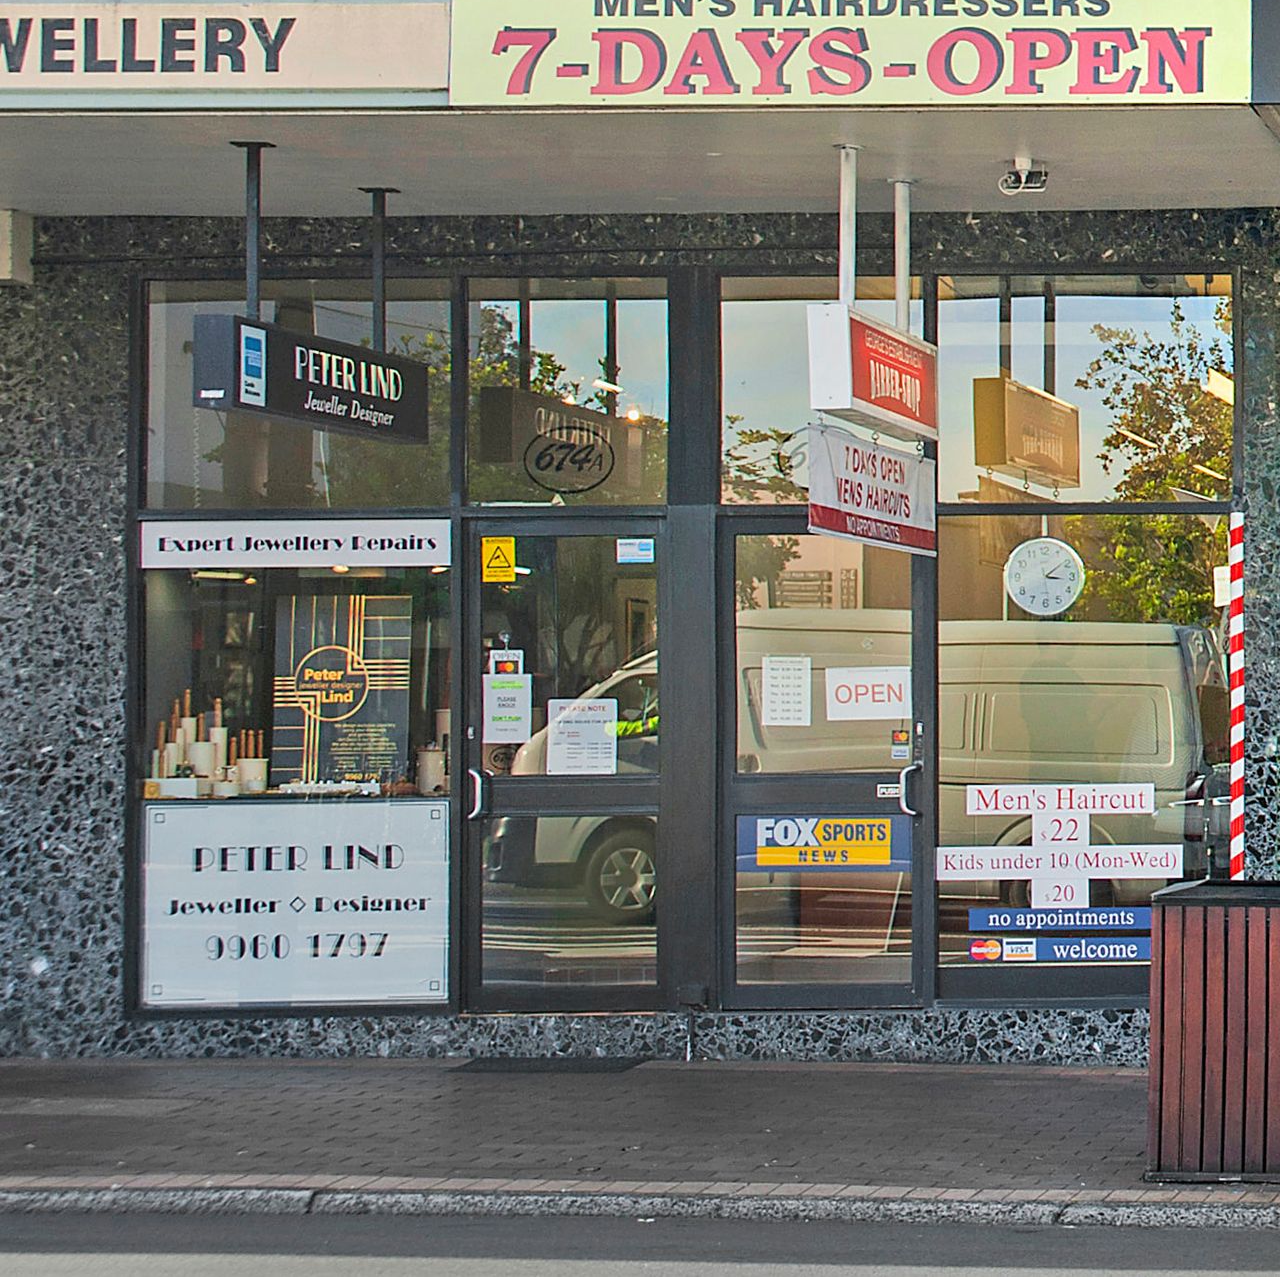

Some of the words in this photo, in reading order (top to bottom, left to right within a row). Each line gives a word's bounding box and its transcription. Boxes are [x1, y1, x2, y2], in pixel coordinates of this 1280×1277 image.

[295, 346, 356, 393] PETER
[360, 361, 403, 402] LIND
[869, 359, 920, 417] BARBER-SHOP
[304, 390, 348, 417] Jeweller
[350, 400, 394, 426] Designer
[535, 443, 603, 472] 674A
[845, 445, 850, 470] 7
[852, 448, 877, 479] DAYS
[880, 455, 905, 485] OPEN
[866, 483, 911, 519] HAIRCUTS
[857, 518, 899, 542] APPOINTMENTS
[157, 536, 235, 552] Expert
[240, 536, 345, 551] Jewellery
[351, 534, 437, 550] Repairs
[303, 668, 344, 681] Peter
[322, 690, 353, 703] Lind
[835, 683, 903, 703] OPEN
[975, 789, 1046, 811] Men's
[1056, 788, 1146, 810] Haircut
[757, 818, 821, 846] FOX
[822, 824, 887, 841] SPORTS
[1041, 819, 1079, 841] $22
[193, 845, 308, 872] PETER
[323, 844, 404, 870] LIND
[799, 850, 848, 862] NEWS
[943, 854, 984, 870] Kids
[990, 853, 1043, 869] under
[1050, 853, 1069, 868] 10
[1075, 852, 1177, 871] (Mon-Wed)
[1045, 885, 1075, 902] $20
[163, 898, 281, 915] Jeweller
[314, 896, 431, 912] Designer
[988, 913, 1011, 926] no
[1016, 909, 1134, 929] appointments
[205, 934, 290, 960] 9960
[306, 932, 389, 958] 1797
[1053, 939, 1138, 958] welcome
